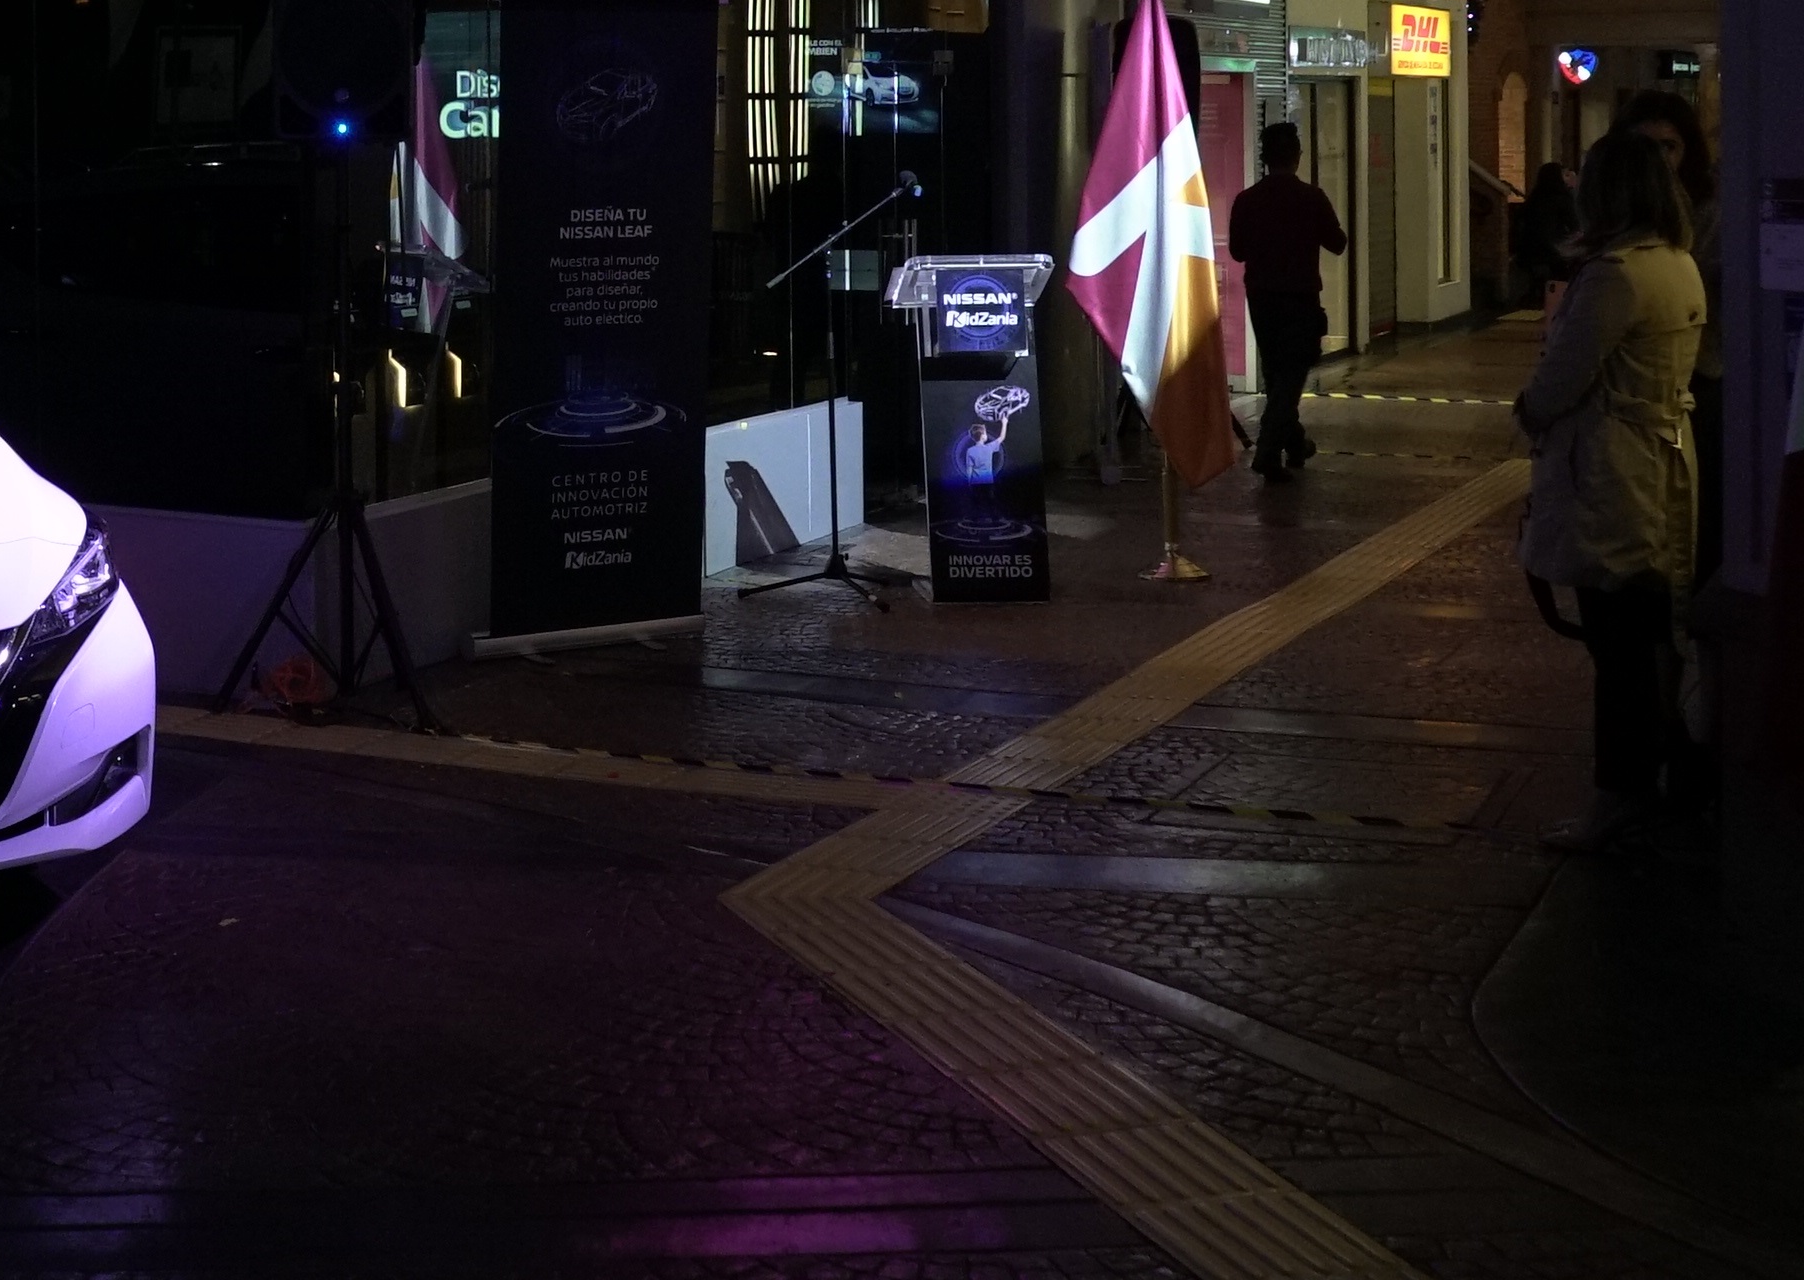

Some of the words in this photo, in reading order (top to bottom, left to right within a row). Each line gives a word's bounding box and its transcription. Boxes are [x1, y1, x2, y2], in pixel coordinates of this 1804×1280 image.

[570, 206, 624, 222] DISEÑA
[627, 208, 647, 221] TU
[559, 226, 614, 239] NISSAN
[617, 225, 653, 238] LEAF
[549, 256, 600, 268] Muestra
[602, 255, 613, 266] al
[616, 254, 660, 266] mundo
[558, 271, 578, 282] tus
[566, 286, 593, 299] para
[943, 293, 1012, 305] NISSAN
[549, 299, 600, 312] creando
[603, 300, 616, 310] tu
[619, 298, 658, 312] propio
[564, 315, 593, 326] auto
[945, 310, 1019, 328] KidZania
[552, 471, 622, 487] CENTRO
[628, 470, 648, 482] DE
[552, 483, 648, 504] INNOVACIÓN
[551, 502, 648, 520] AUTOMOTRIZ
[564, 528, 628, 544] NISSAN
[564, 549, 632, 570] KidZania
[948, 554, 1012, 566] INNOVAR
[1014, 554, 1033, 566] ES
[949, 566, 1033, 578] DIVERTIDO
